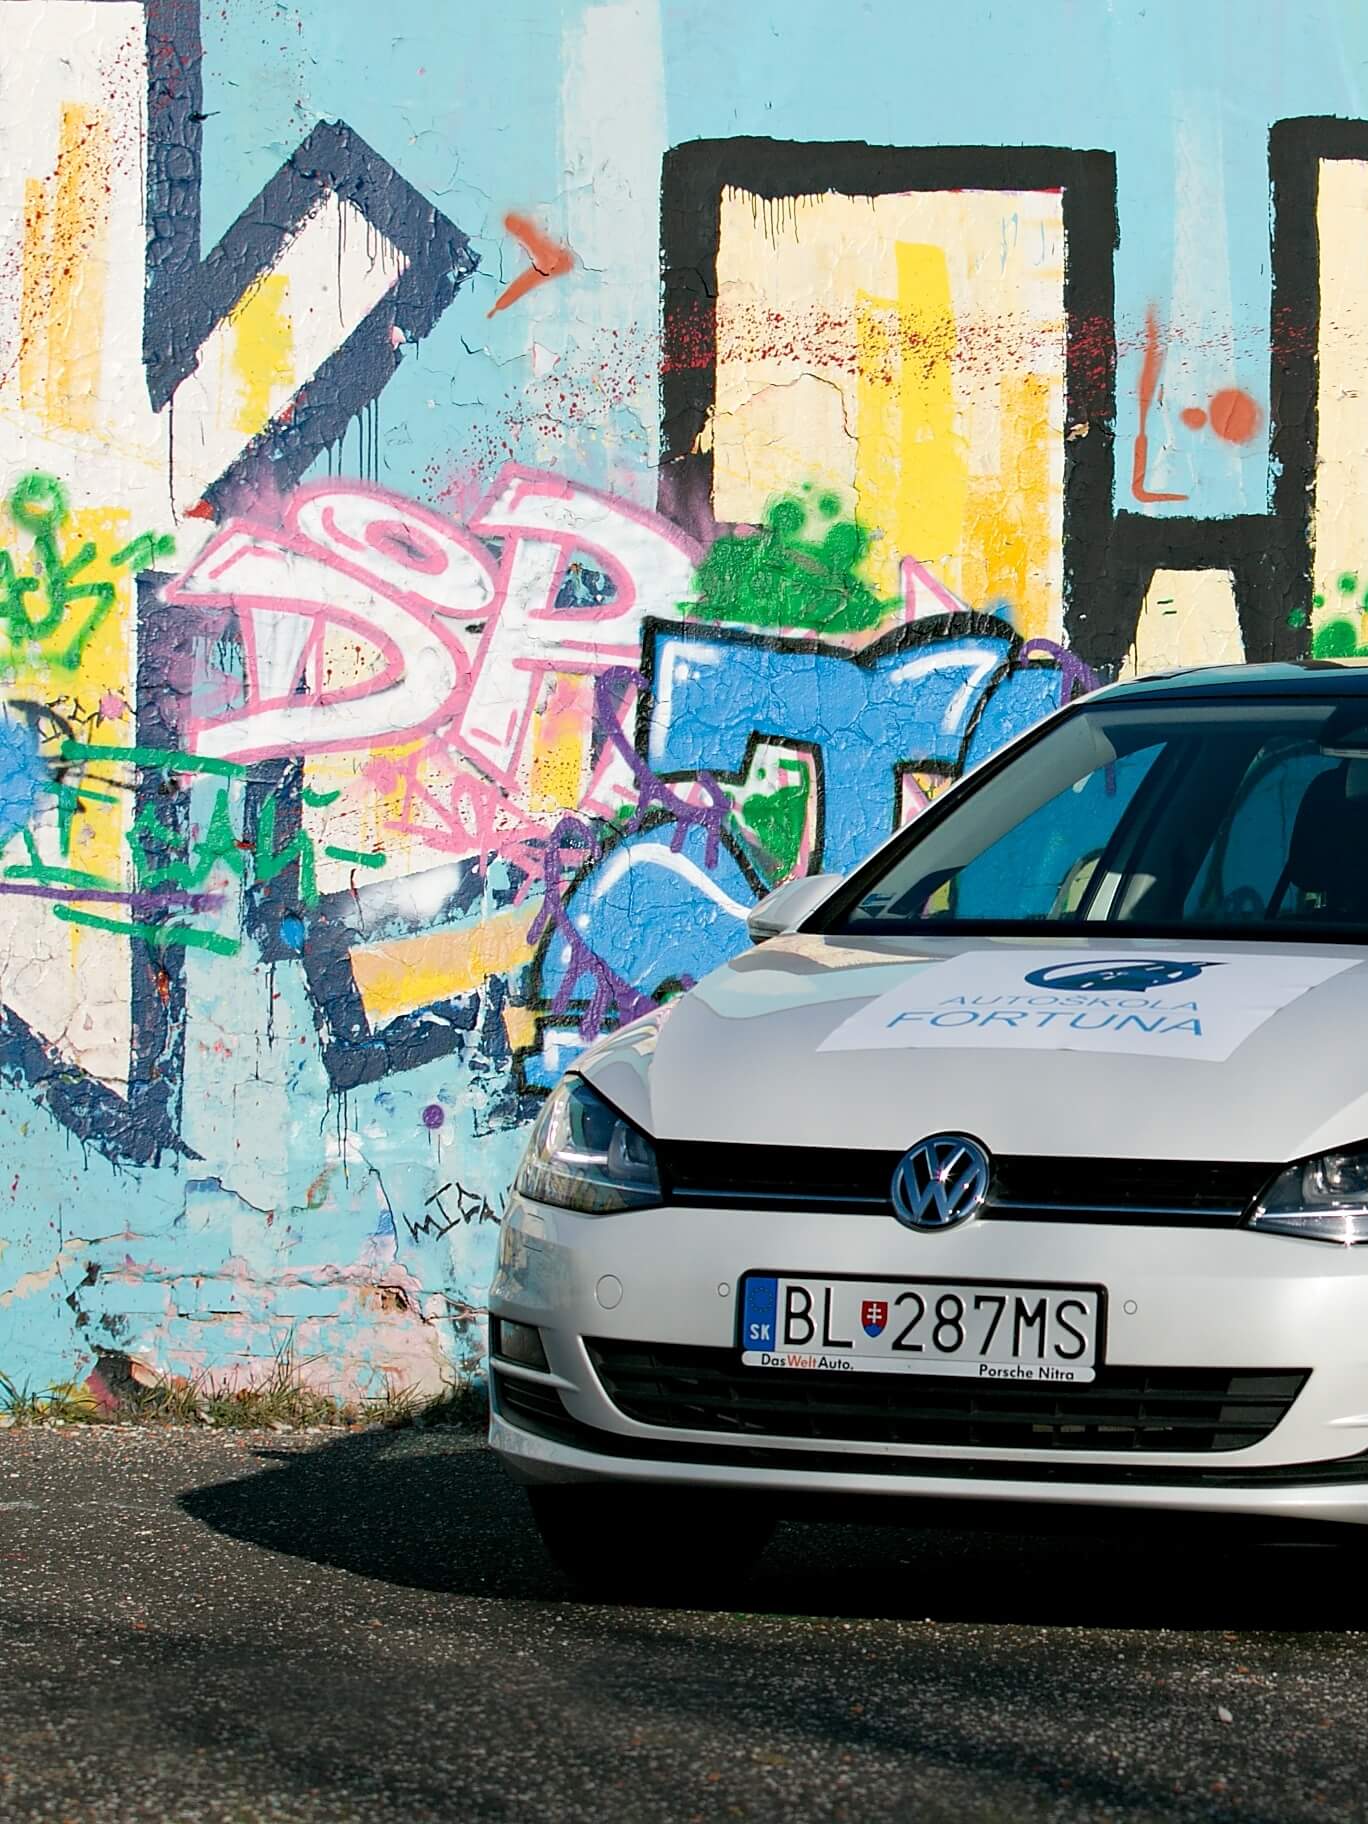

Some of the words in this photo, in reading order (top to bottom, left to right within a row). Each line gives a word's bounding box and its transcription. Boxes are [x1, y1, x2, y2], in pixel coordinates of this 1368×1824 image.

[939, 994, 1200, 1011] AUTOŠKOLA
[885, 1010, 1204, 1037] FORTUNA
[749, 1322, 771, 1342] SK
[783, 1285, 854, 1349] BL
[891, 1292, 1090, 1361] 287MS
[978, 1363, 1034, 1380] Porsche
[1038, 1366, 1075, 1381] Nitra
